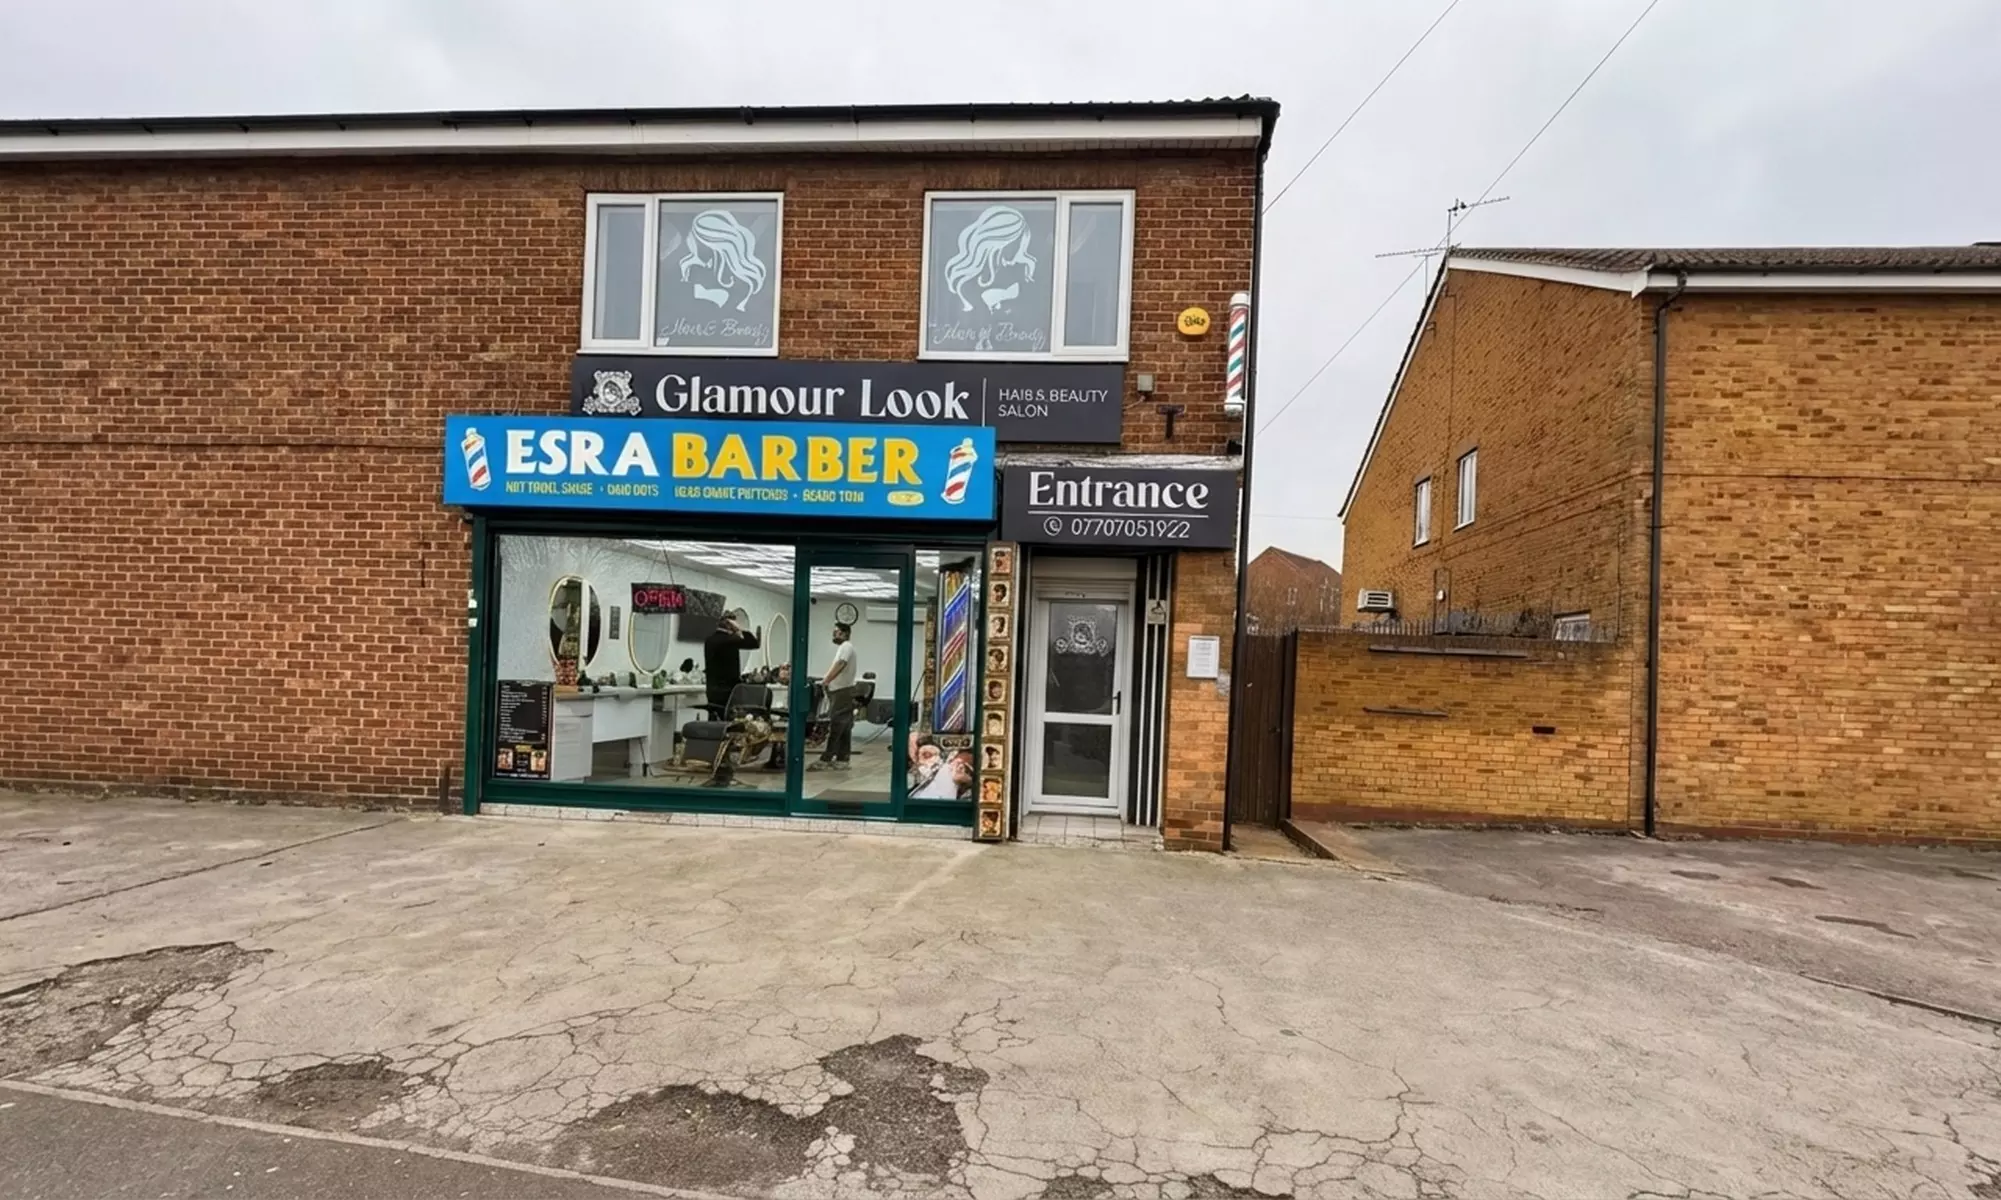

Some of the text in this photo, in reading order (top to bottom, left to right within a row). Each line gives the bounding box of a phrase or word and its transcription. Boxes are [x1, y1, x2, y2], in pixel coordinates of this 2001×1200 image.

[655, 374, 970, 420] Glamour Look
[1049, 388, 1108, 403] BEAUTY
[998, 404, 1048, 418] SALON
[505, 429, 923, 485] ESRA BARBER
[1029, 471, 1209, 509] Entrance
[1071, 518, 1191, 539] 07707051922
